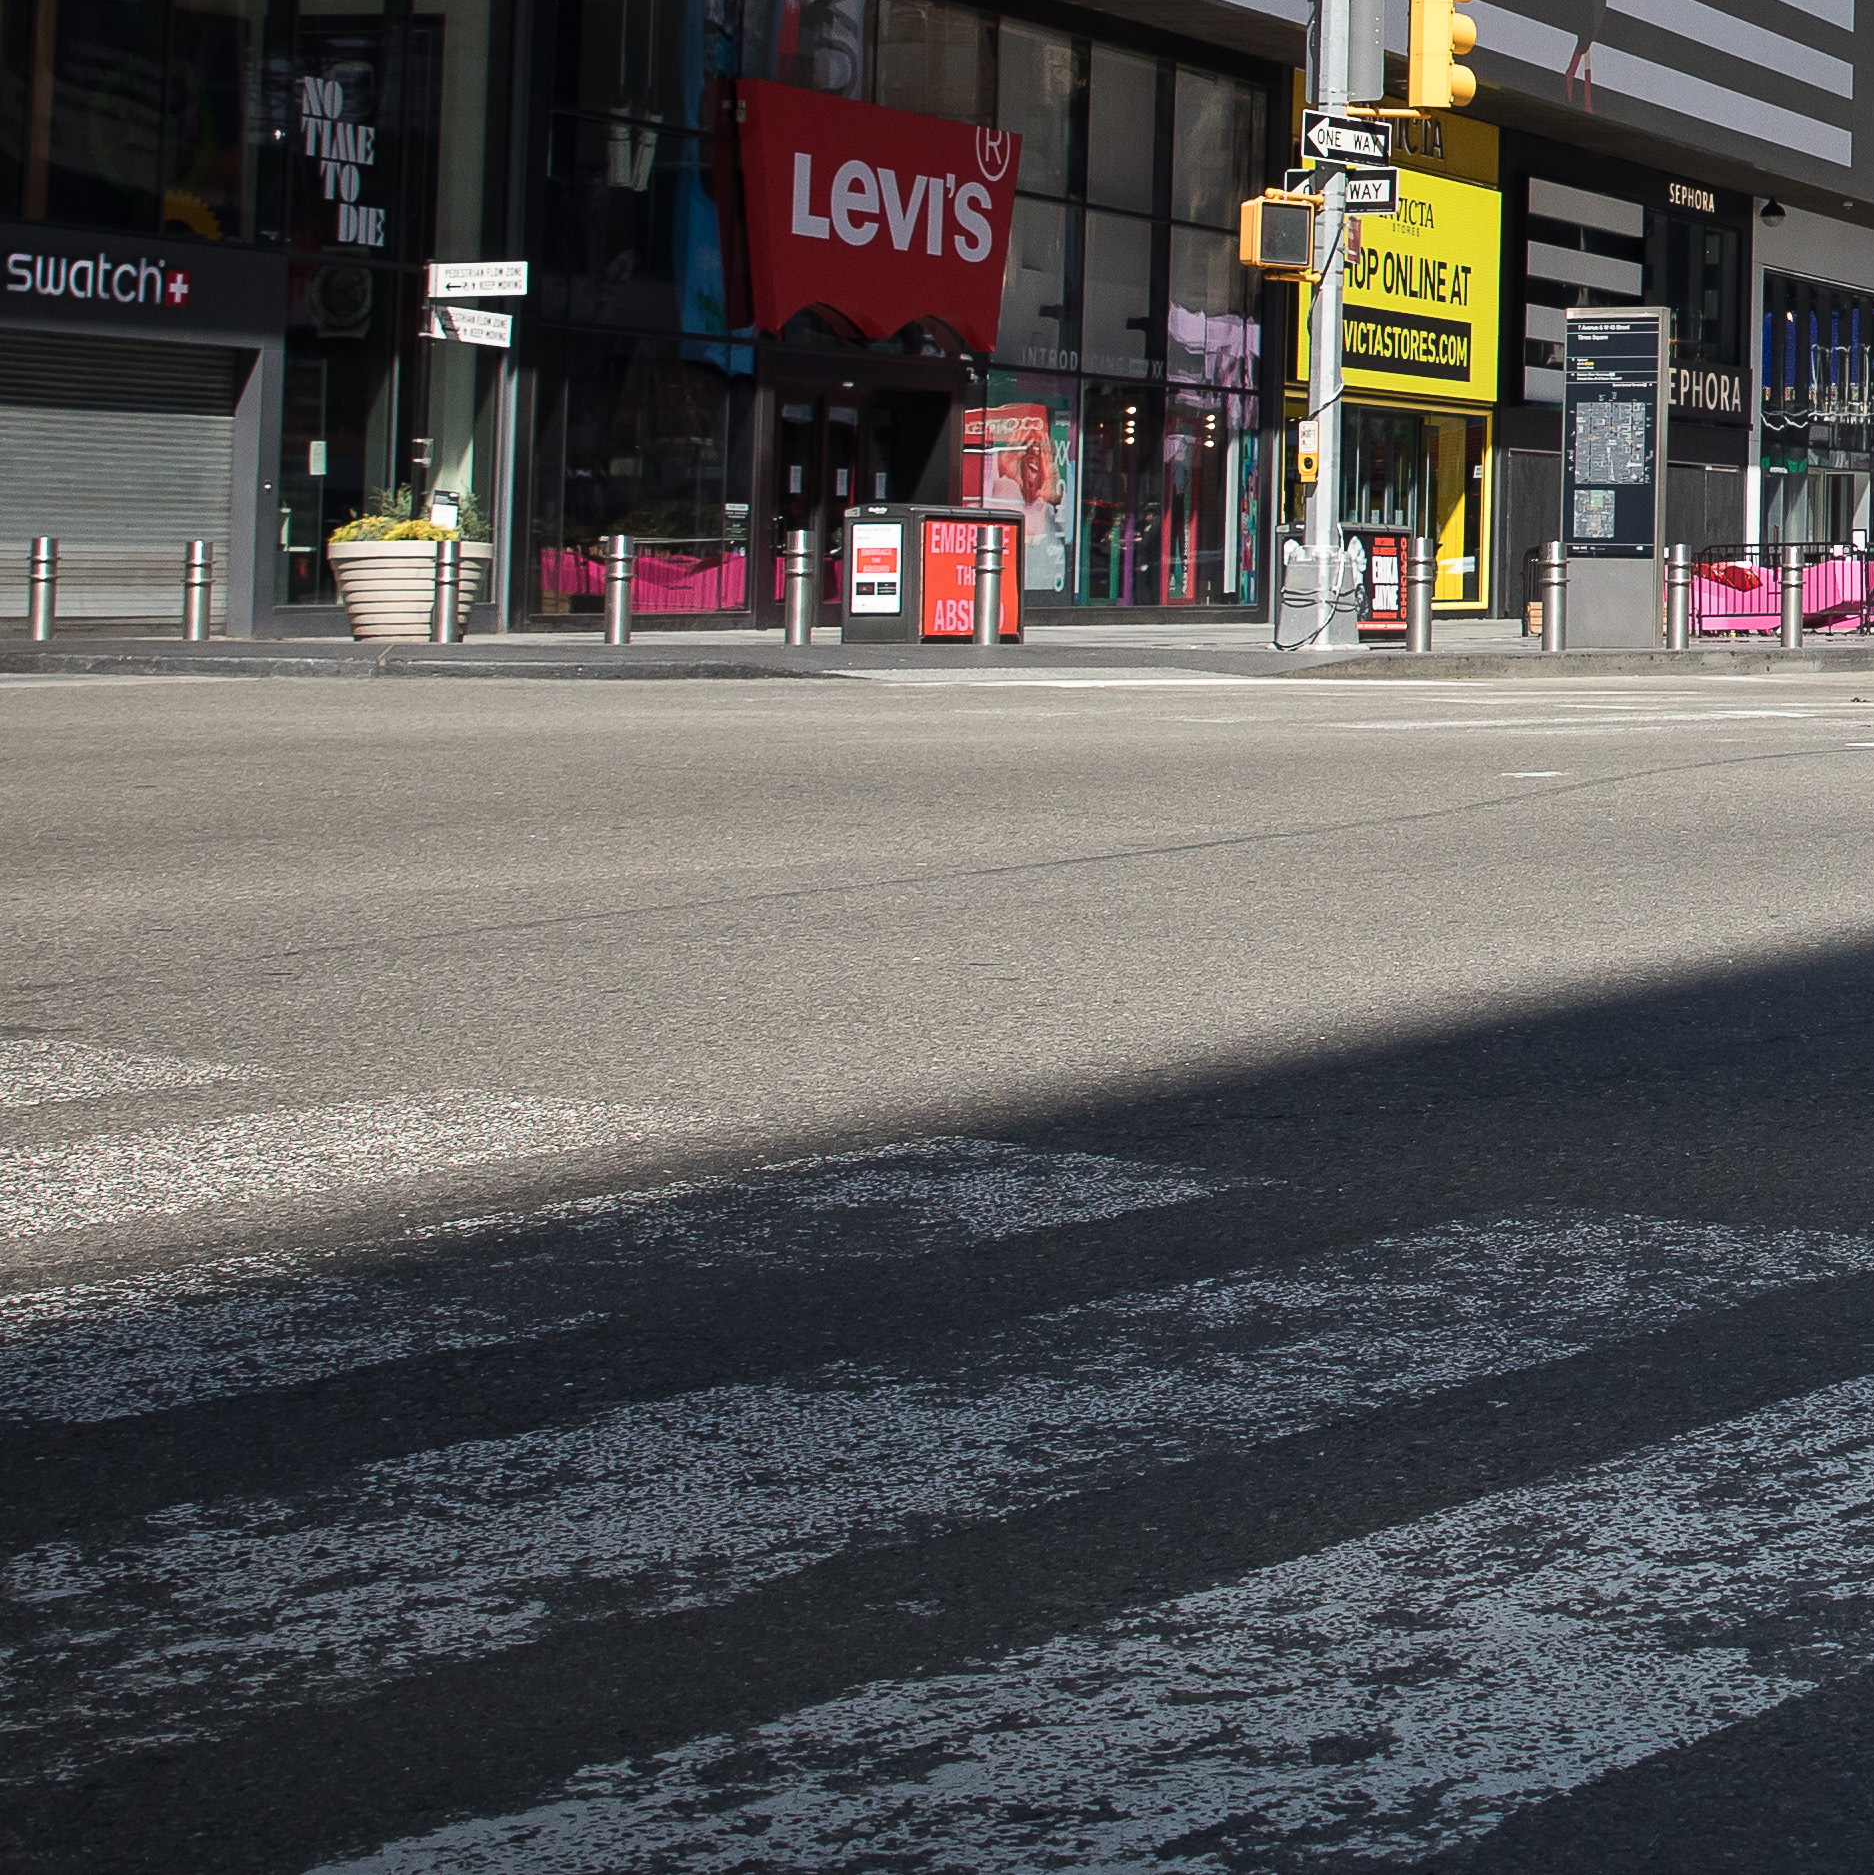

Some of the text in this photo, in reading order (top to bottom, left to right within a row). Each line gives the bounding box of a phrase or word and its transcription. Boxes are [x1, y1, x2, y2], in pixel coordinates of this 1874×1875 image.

[302, 75, 345, 121] NO
[302, 116, 378, 167] TIME
[1317, 128, 1381, 154] ONE WAY
[319, 161, 362, 204] TO
[1349, 182, 1383, 200] WAY
[1669, 181, 1716, 215] SEPHORA
[337, 204, 387, 248] DIE
[6, 252, 164, 305] swatch
[1383, 251, 1472, 307] ONLINE AT
[1343, 319, 1468, 368] VICTASTORES.COM
[1669, 366, 1742, 414] EPHORA
[931, 523, 1011, 556] EMBRE
